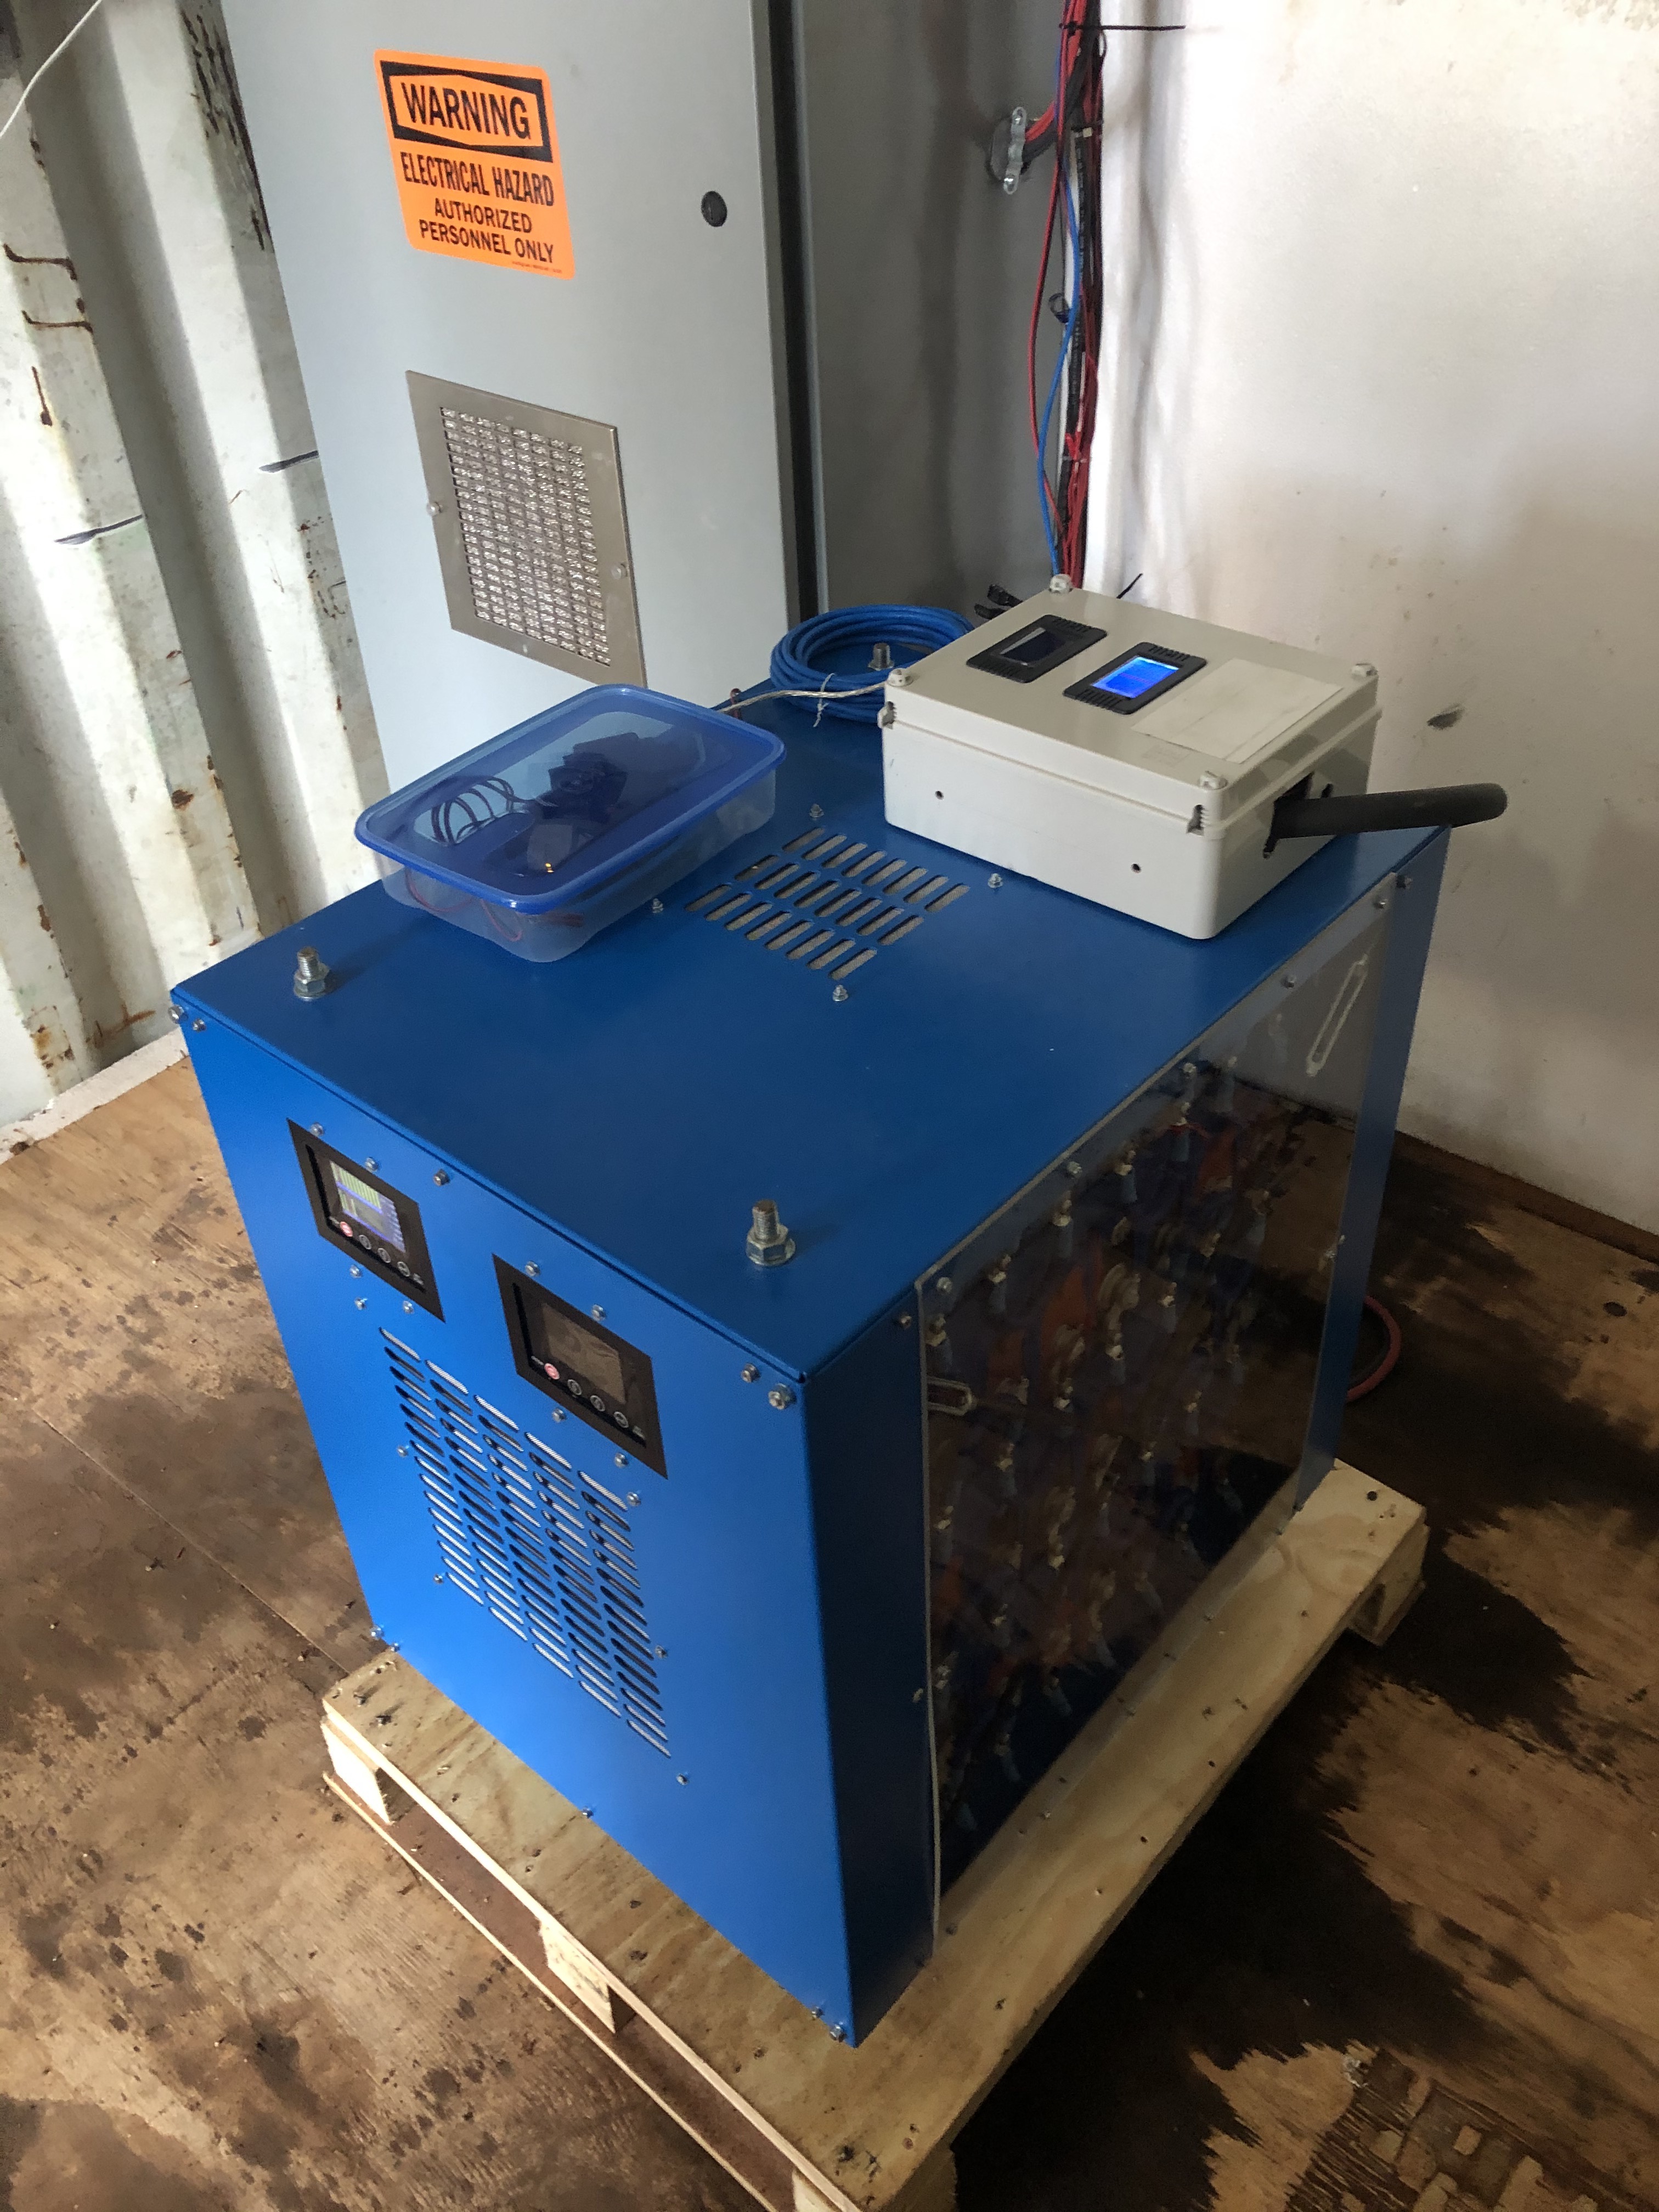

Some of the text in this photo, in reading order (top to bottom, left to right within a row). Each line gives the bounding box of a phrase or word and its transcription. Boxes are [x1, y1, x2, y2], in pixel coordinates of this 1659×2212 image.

[400, 82, 531, 139] WARNING
[400, 151, 554, 207] ELECTRICAL HAZARD
[435, 198, 532, 233] AUTHORIZED
[419, 219, 554, 263] PERSONNEL ONLY
